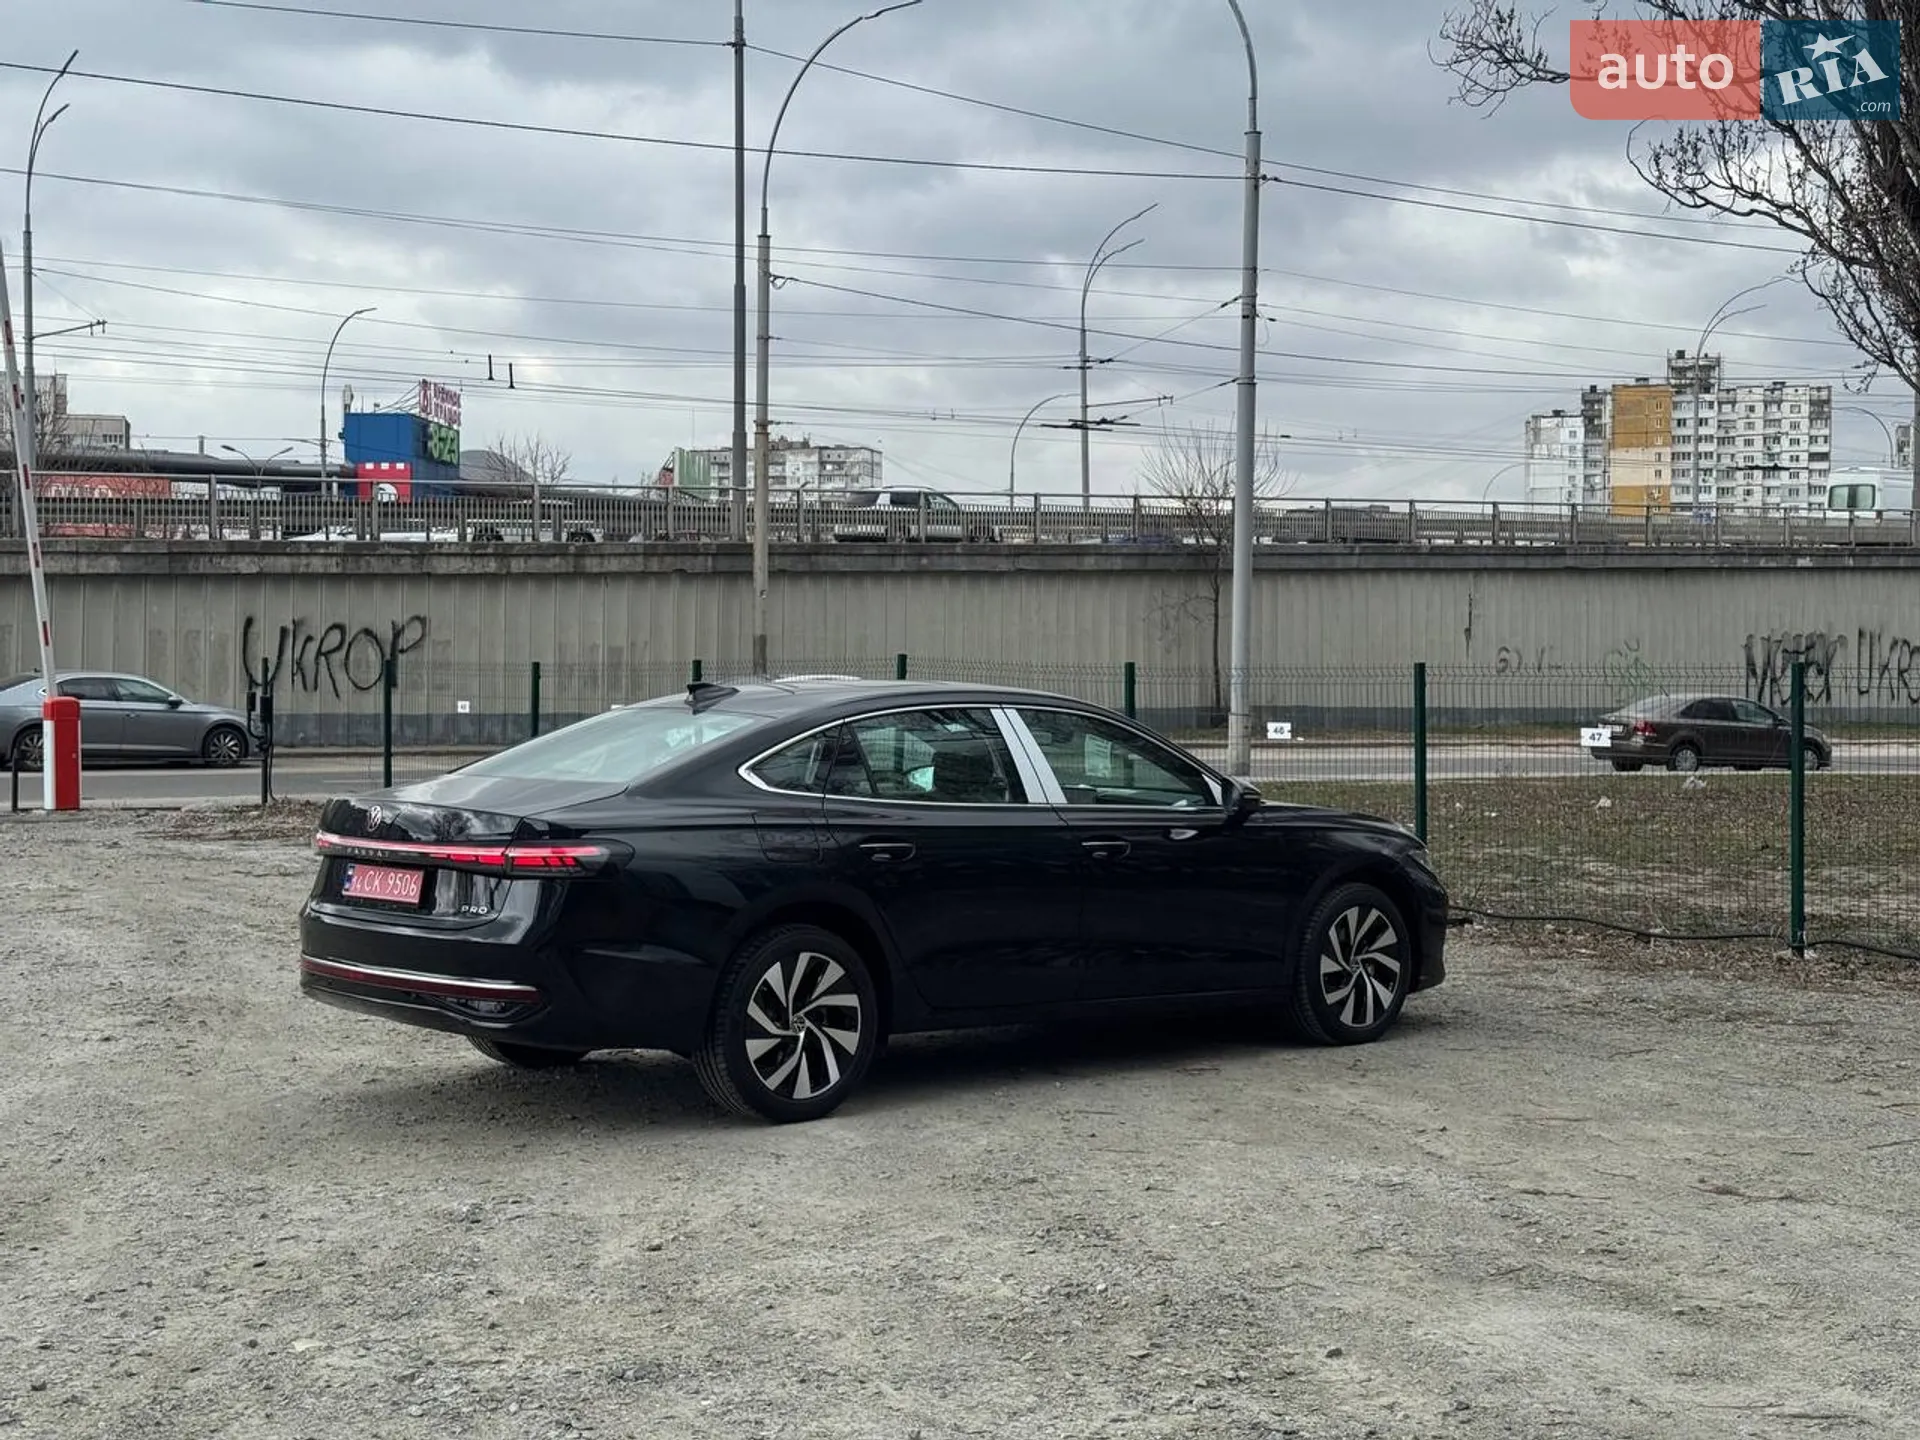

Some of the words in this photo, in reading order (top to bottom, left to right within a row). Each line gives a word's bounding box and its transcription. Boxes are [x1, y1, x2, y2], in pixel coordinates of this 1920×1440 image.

[243, 616, 427, 699] UKROP
[1588, 732, 1603, 742] 47
[385, 872, 419, 896] 9506
[460, 904, 488, 915] PRO
